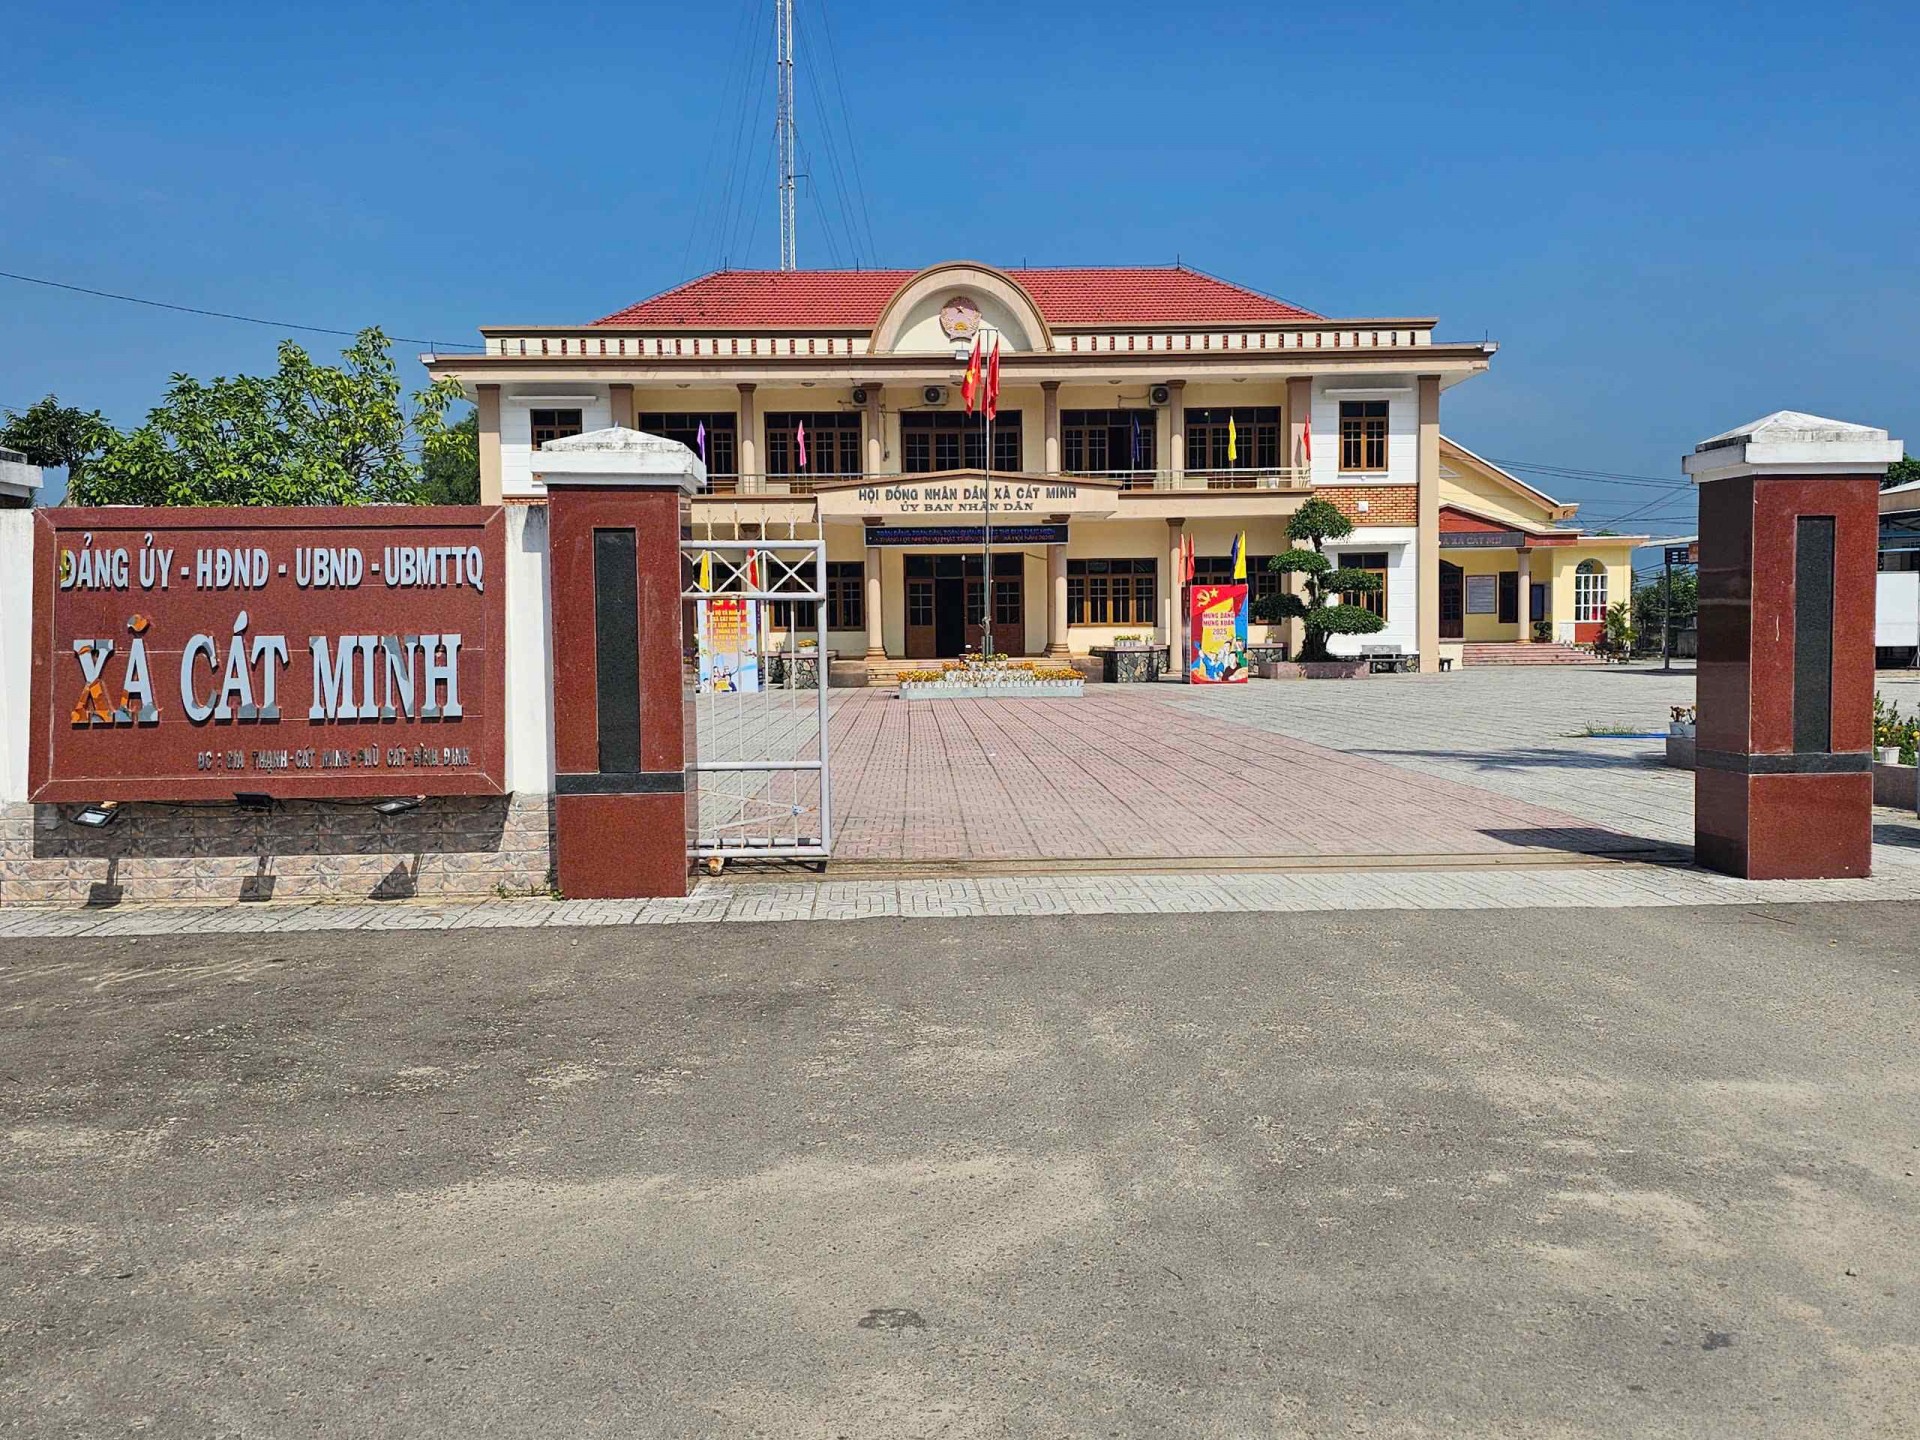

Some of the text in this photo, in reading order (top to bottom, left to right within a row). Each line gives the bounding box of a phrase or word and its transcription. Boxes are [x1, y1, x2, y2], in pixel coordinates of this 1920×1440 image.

[924, 486, 957, 500] NHÂN
[963, 485, 987, 500] DÂN
[1016, 484, 1040, 499] CÁT
[1046, 486, 1077, 499] MINH
[924, 503, 953, 512] BAN
[960, 501, 998, 511] NHÂN
[1003, 501, 1033, 511] DÂN
[59, 532, 130, 588] ĐẢNG
[139, 532, 174, 588] ỦY
[197, 549, 270, 588] HĐND
[296, 548, 364, 587] UBND
[384, 545, 484, 592] UBMTTQ
[71, 610, 463, 725] XÃ CÁT MINH
